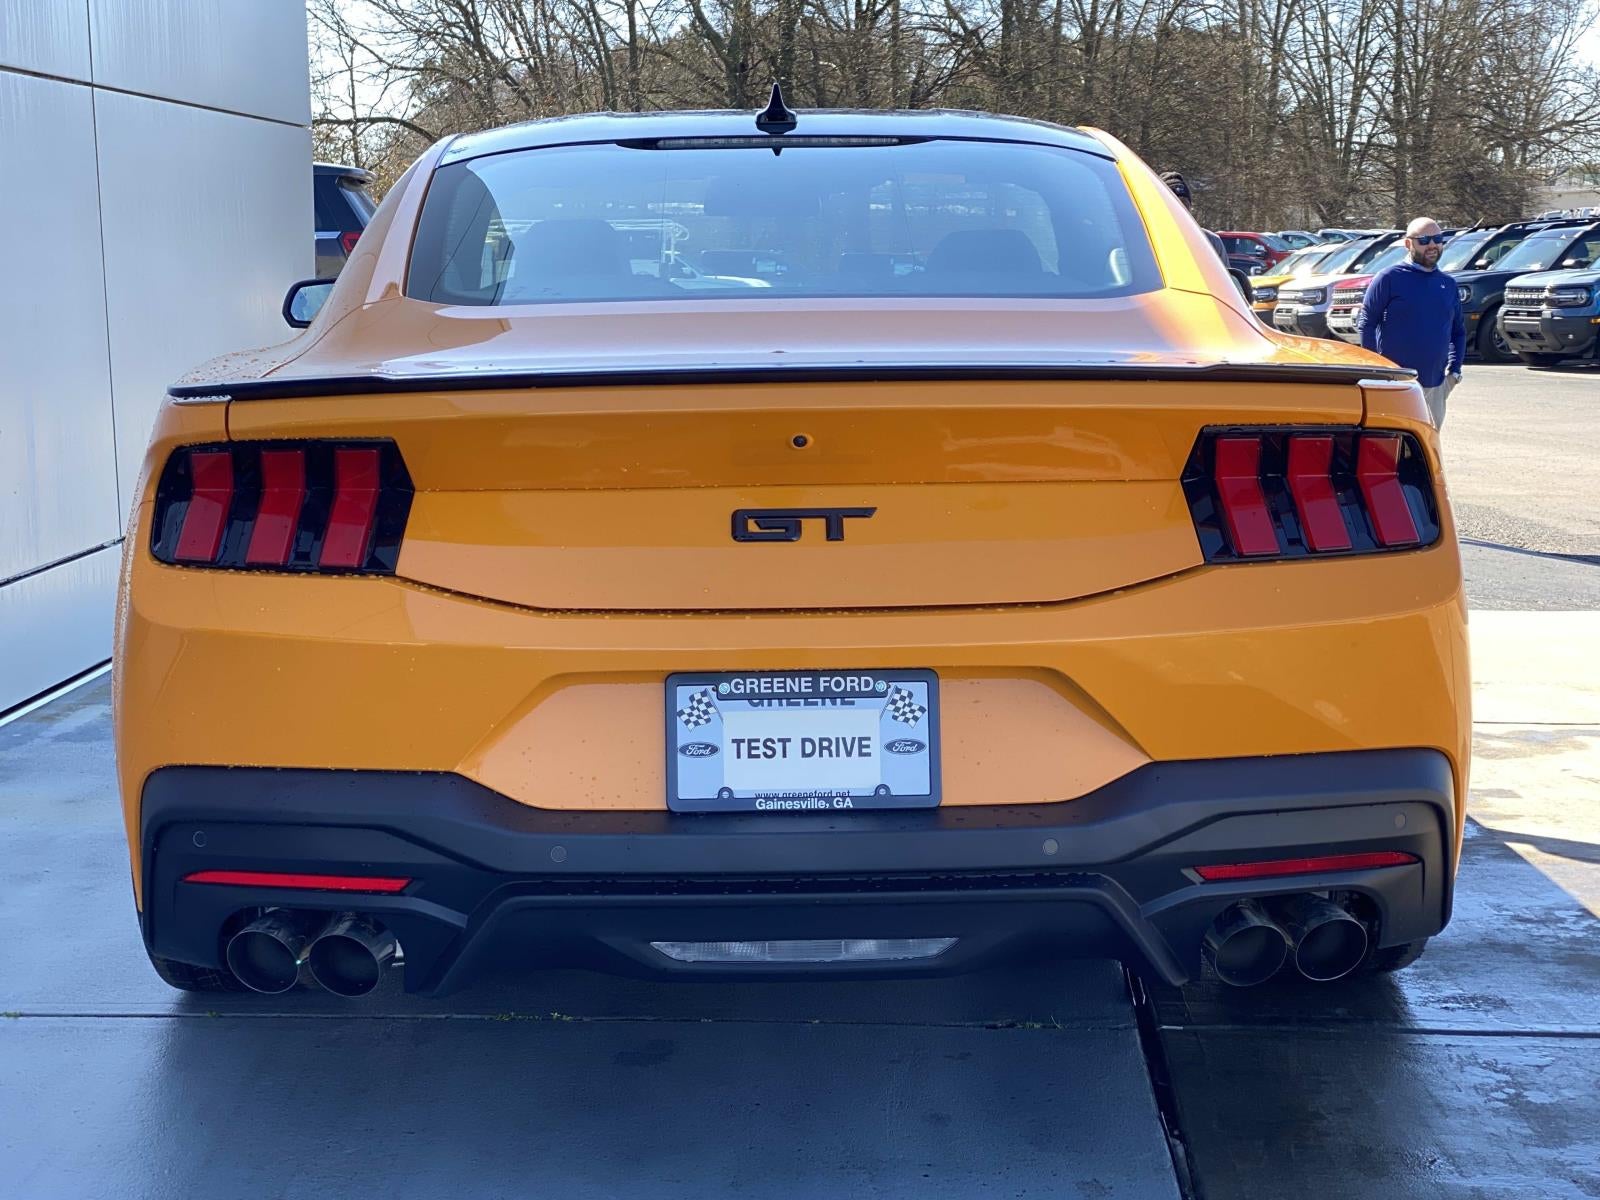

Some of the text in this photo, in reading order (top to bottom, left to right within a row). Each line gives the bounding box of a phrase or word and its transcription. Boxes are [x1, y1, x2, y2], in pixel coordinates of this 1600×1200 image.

[731, 507, 877, 542] GT
[730, 676, 874, 694] GREENE FORD
[686, 745, 711, 754] Ford
[731, 737, 872, 759] TEST DRIVE
[892, 741, 918, 752] Ford
[754, 790, 851, 798] wwwreenefordnet
[755, 797, 853, 809] Gainesville, GA
